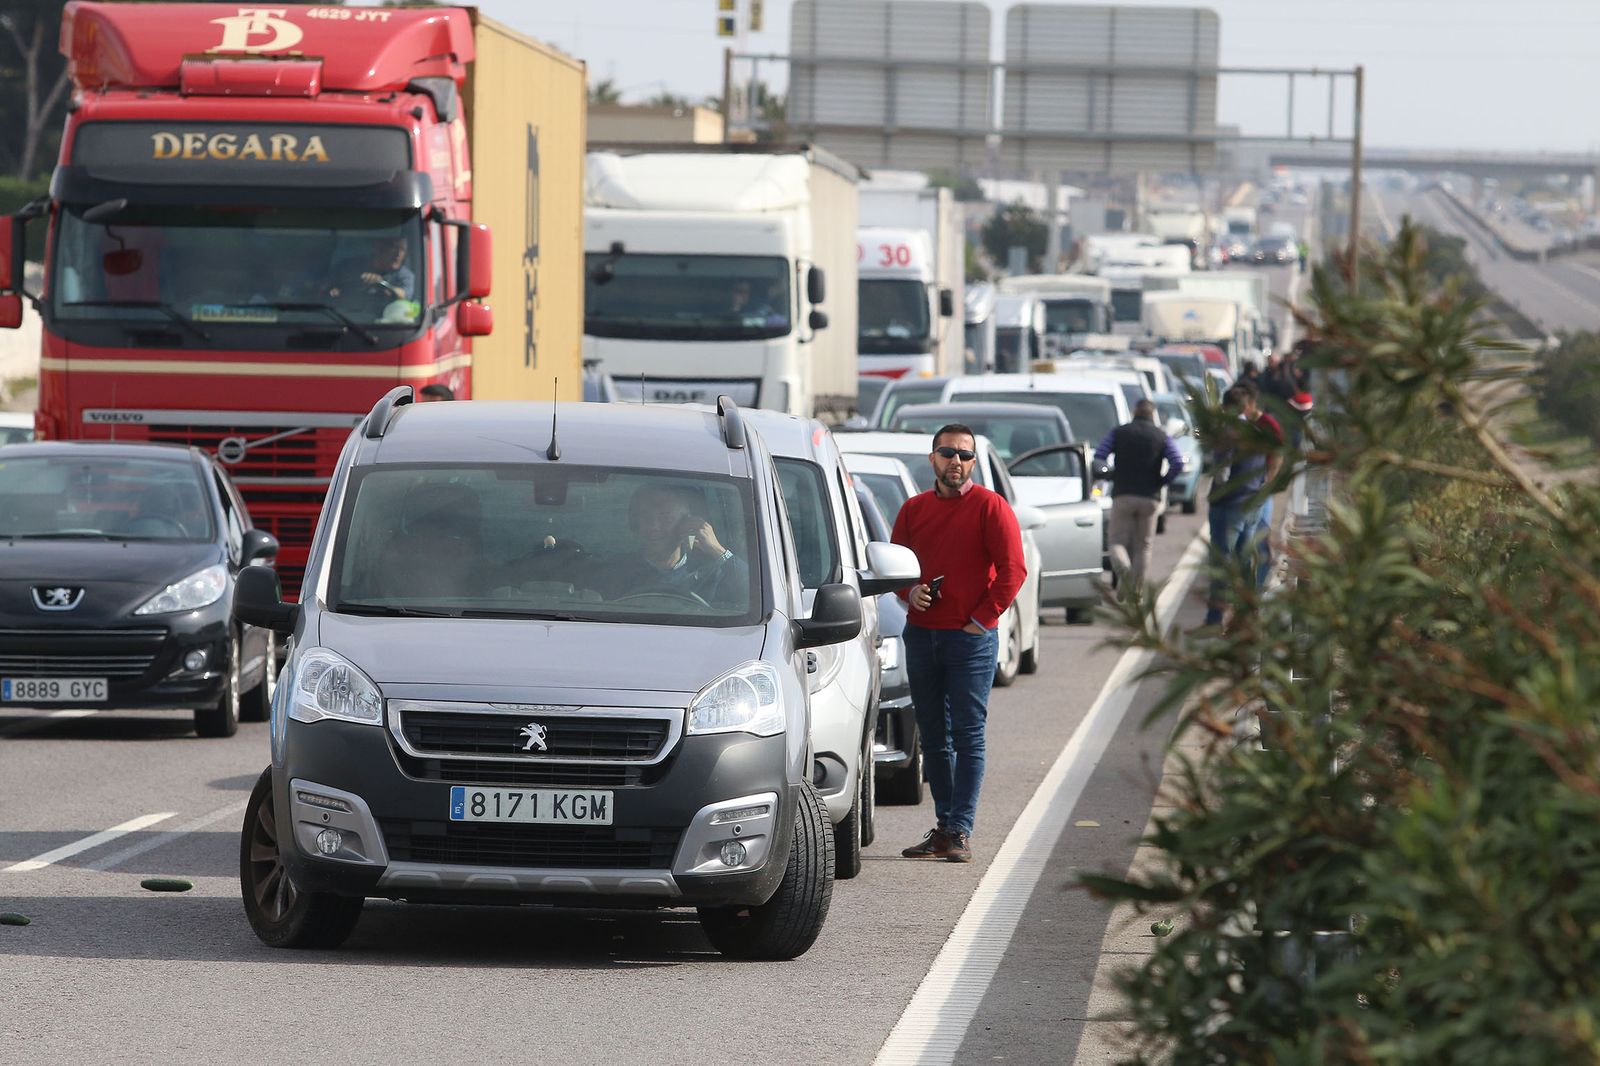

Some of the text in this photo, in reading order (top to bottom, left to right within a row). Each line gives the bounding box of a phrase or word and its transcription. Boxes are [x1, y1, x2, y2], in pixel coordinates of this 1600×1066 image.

[355, 11, 392, 22] JYT
[151, 132, 330, 161] DEGARA
[878, 243, 911, 268] 30
[89, 412, 144, 421] VOLVO
[16, 681, 104, 698] 8889 GYC
[471, 792, 538, 818] 8171
[553, 794, 606, 820] KGM
